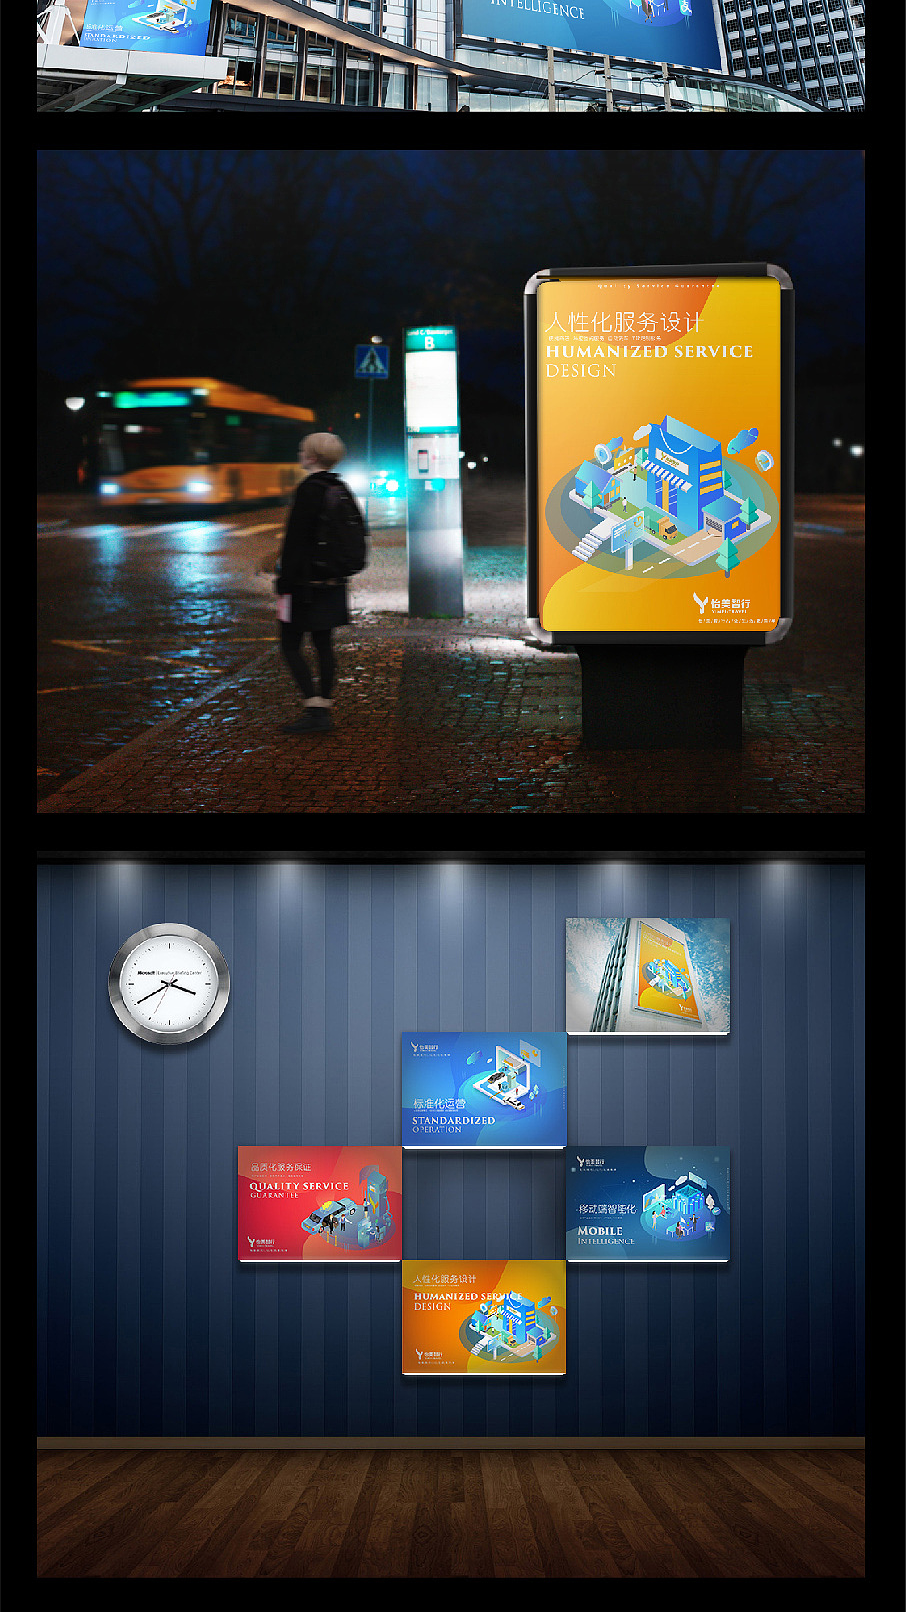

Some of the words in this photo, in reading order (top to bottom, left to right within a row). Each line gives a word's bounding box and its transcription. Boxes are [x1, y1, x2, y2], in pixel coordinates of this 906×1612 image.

[545, 311, 704, 333] 人性化服务设计
[546, 345, 668, 358] HUMANIZED
[674, 345, 753, 358] SERVICE
[546, 363, 617, 378] DESIGN
[711, 598, 750, 609] 怡美智行
[412, 1116, 496, 1125] STANDARDIZED
[250, 1182, 300, 1193] QUALITY
[302, 1182, 349, 1191] SERVICE
[414, 1292, 478, 1301] HUMANIZED
[414, 1302, 451, 1311] DESIGN
